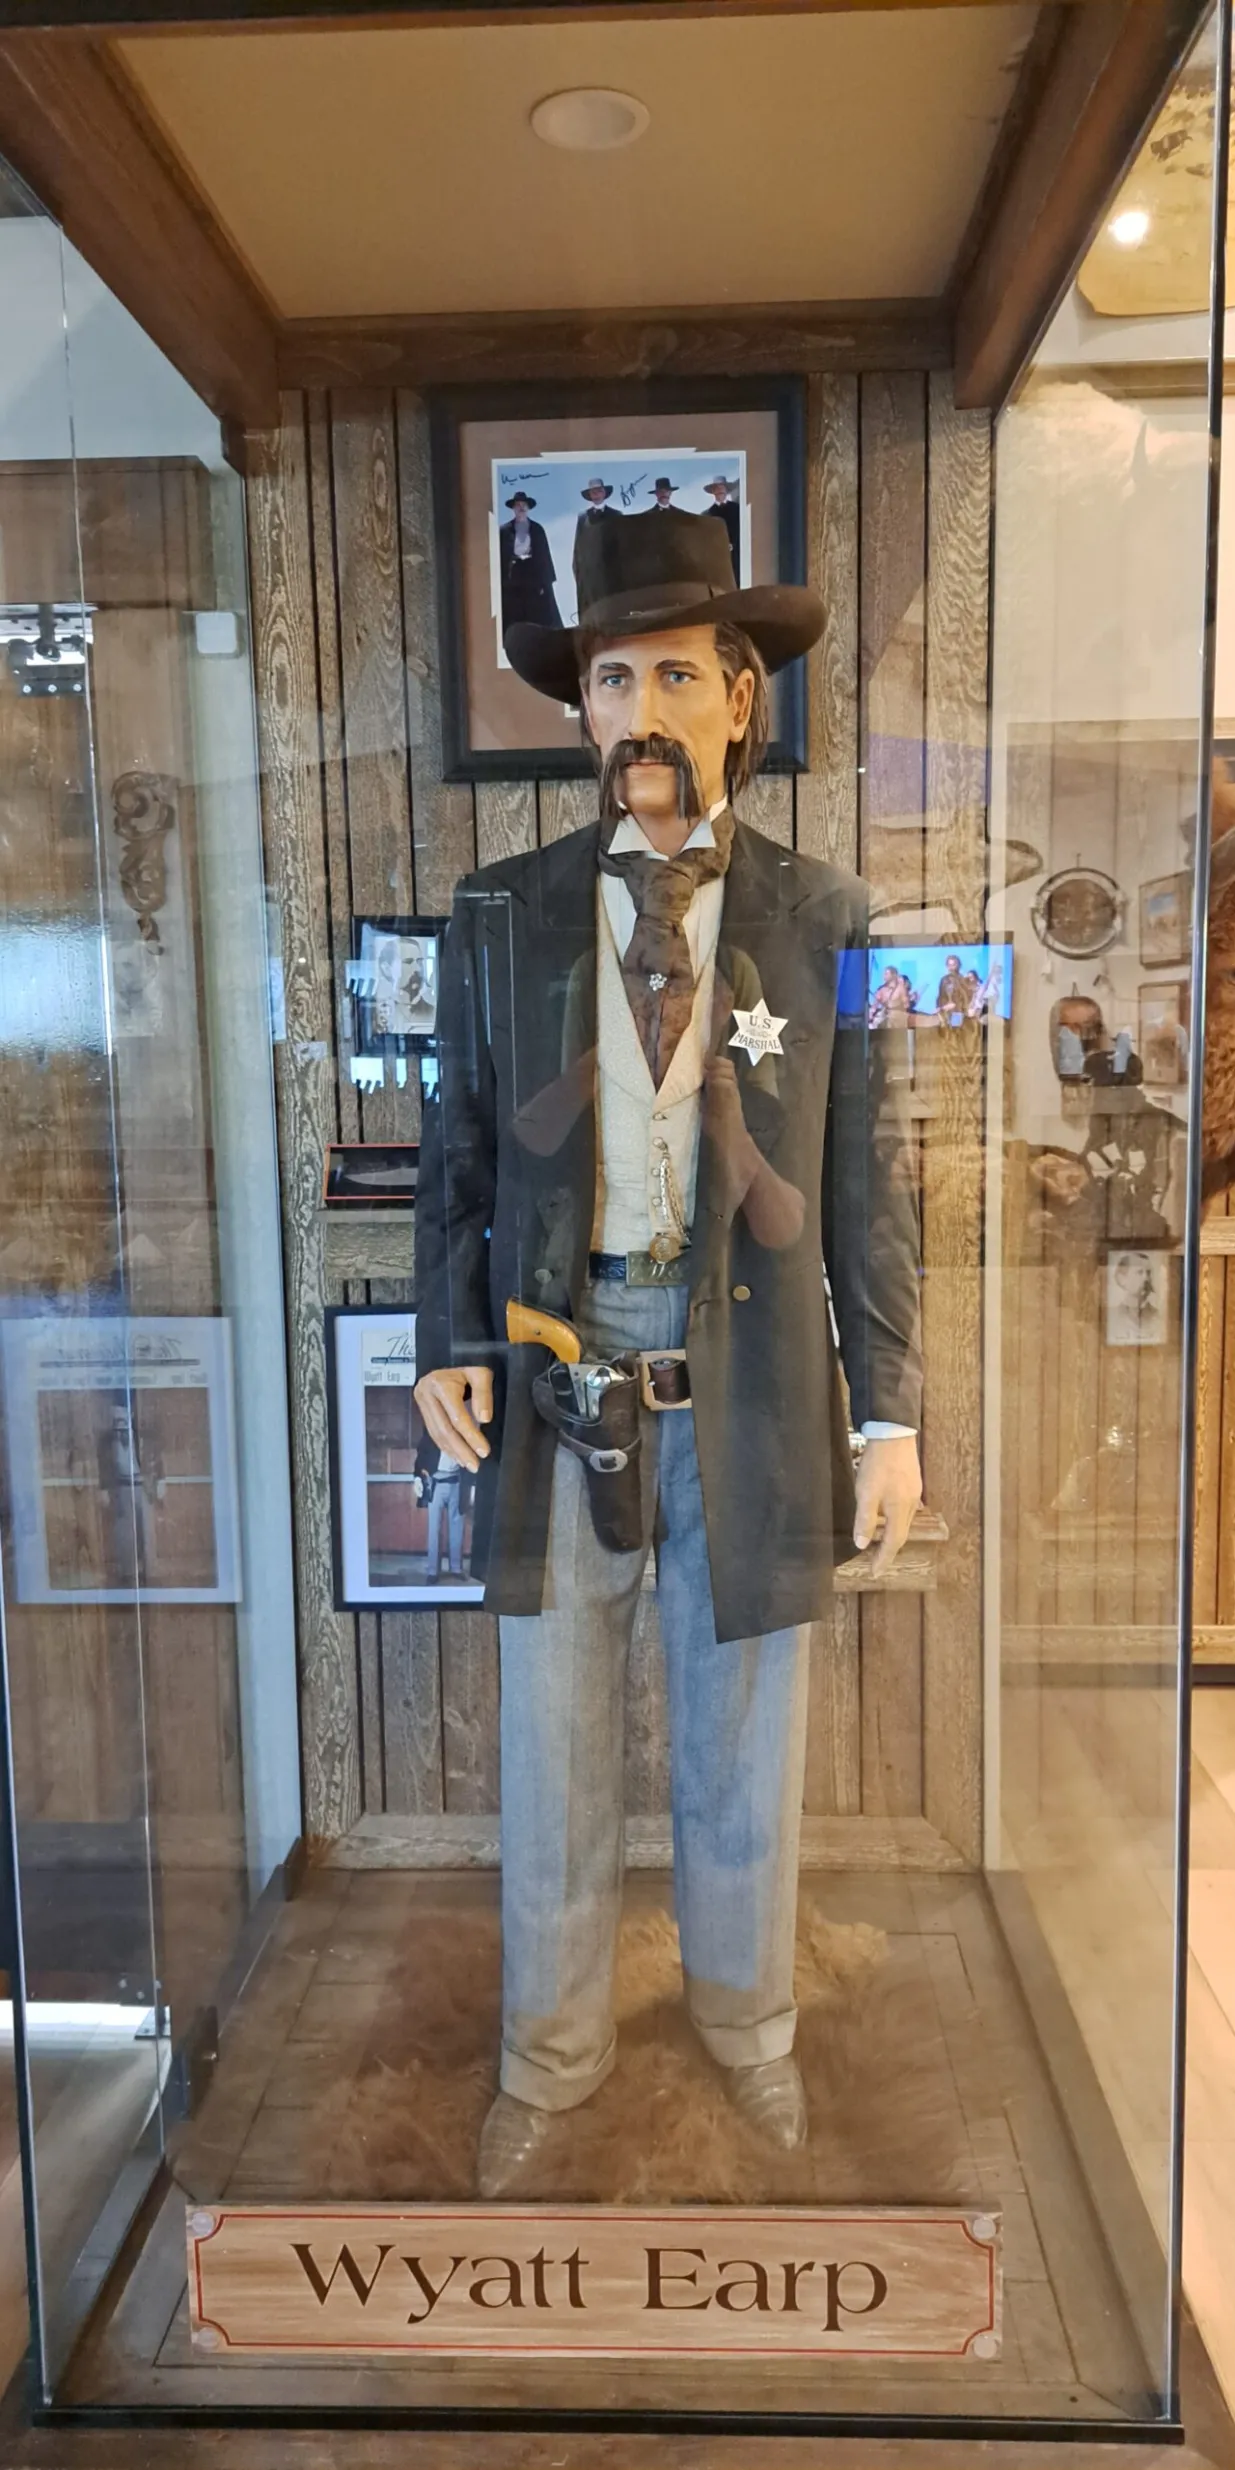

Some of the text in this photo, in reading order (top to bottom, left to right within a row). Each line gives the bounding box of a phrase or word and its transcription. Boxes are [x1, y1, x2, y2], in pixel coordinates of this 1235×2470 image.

[735, 1034, 779, 1050] MARSHAL
[291, 2243, 888, 2332] Wyatt Earp
